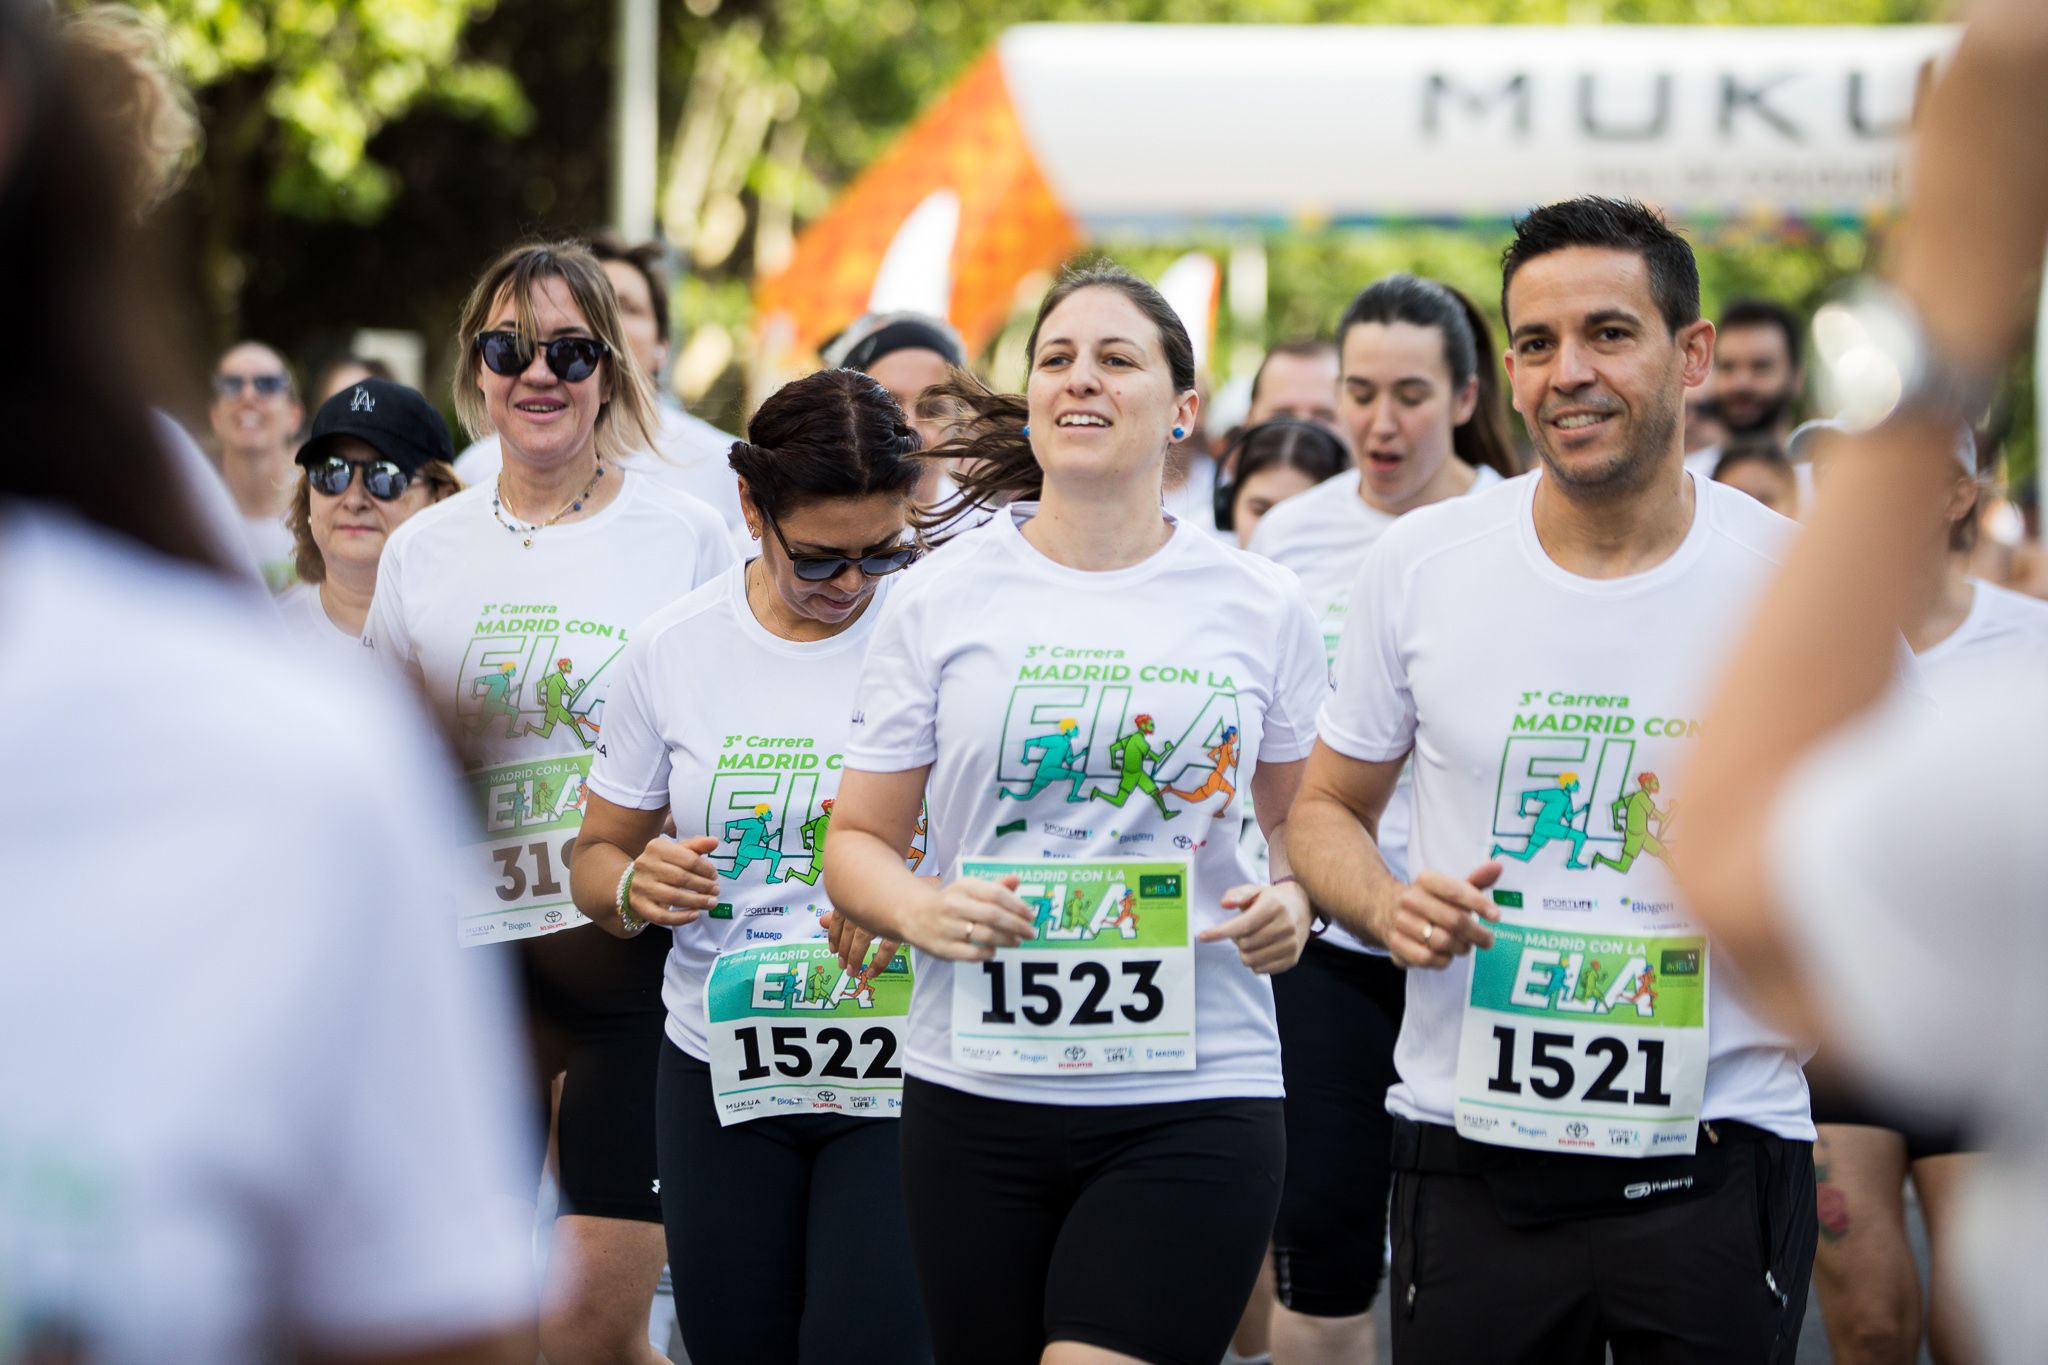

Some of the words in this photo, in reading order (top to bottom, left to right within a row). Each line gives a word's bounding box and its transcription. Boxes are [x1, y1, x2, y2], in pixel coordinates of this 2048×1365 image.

[351, 385, 375, 412] LA
[500, 603, 558, 615] Carrera
[475, 619, 560, 634] MADRID
[565, 620, 613, 638] CON
[1050, 646, 1126, 659] Carrera
[1018, 664, 1131, 682] MADRID
[1139, 666, 1199, 684] CON
[1207, 671, 1238, 690] LA
[1547, 691, 1630, 708] Carrera
[1512, 714, 1635, 734] MADRID
[746, 736, 815, 748] Carrera
[717, 753, 819, 770] MADRID
[490, 769, 533, 785] MADRID
[536, 765, 561, 776] CON
[564, 762, 580, 772] LA
[487, 773, 588, 832] ELA
[1072, 869, 1103, 882] CON
[1107, 869, 1126, 882] LA
[1632, 901, 1674, 915] Biogen
[508, 921, 531, 931] Biogen
[754, 931, 783, 940] MADRID
[1524, 932, 1586, 951] MADRID
[1589, 939, 1624, 955] CON
[1627, 942, 1648, 956] LA
[759, 949, 810, 962] MADRID
[751, 962, 874, 1010] ELA
[1510, 947, 1655, 1017] ELA
[982, 960, 1164, 1026] 1523
[734, 1026, 903, 1081] 1522
[1155, 1050, 1186, 1058] MADRID
[1488, 1025, 1671, 1107] 1521
[726, 1099, 761, 1110] MUKUA
[1611, 1136, 1630, 1145] LIFE
